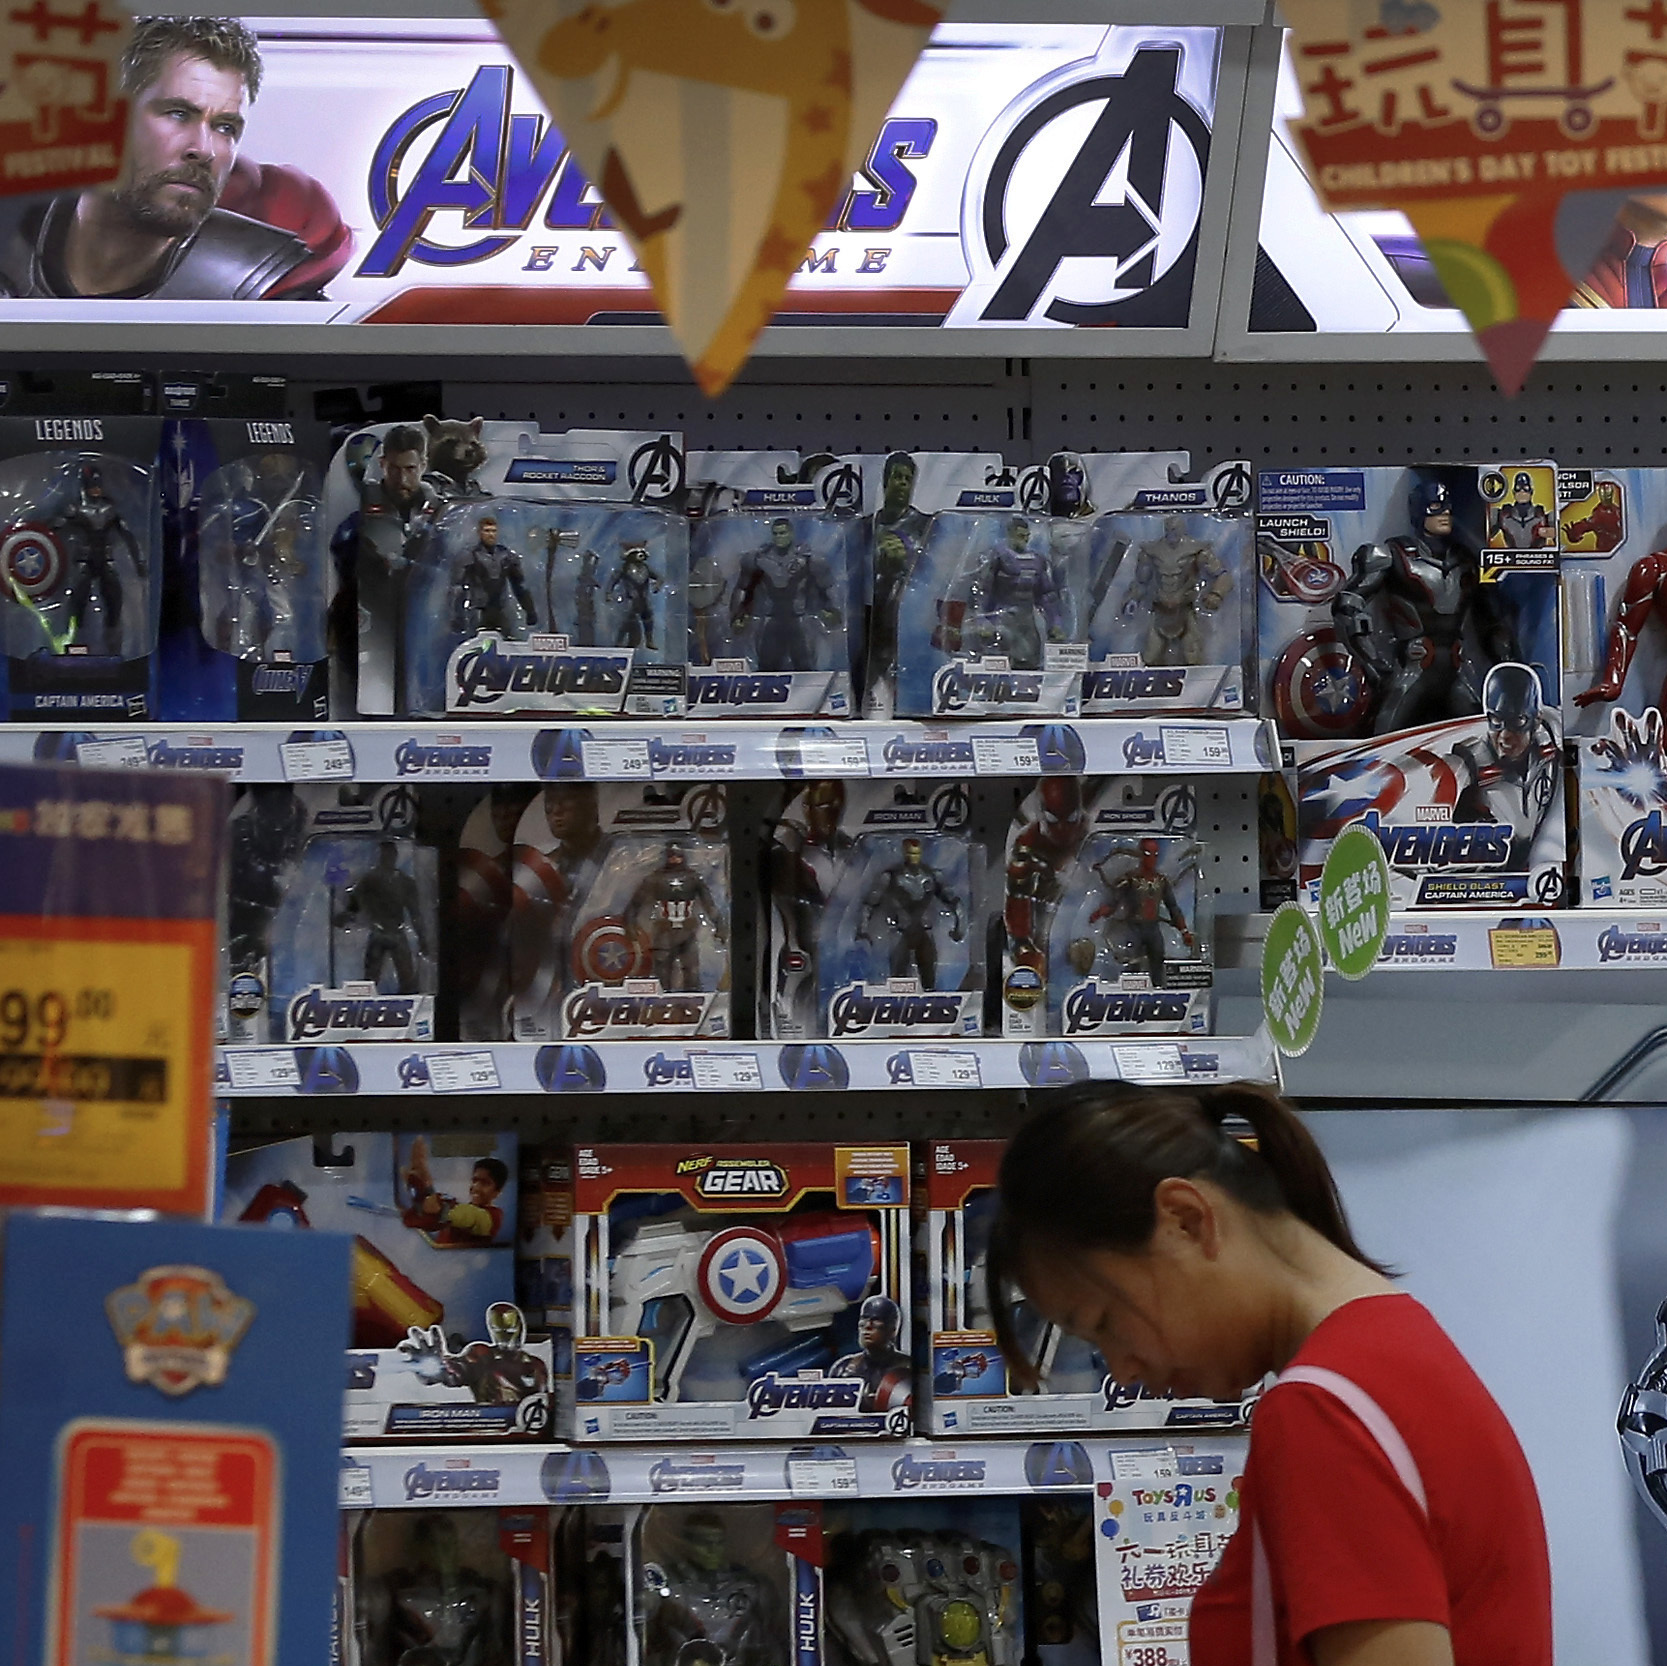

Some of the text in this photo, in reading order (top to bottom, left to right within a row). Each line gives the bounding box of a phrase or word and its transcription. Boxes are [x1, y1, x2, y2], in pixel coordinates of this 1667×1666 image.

[1321, 158, 1472, 191] CHILDREN'S
[1481, 153, 1536, 181] DAY
[1545, 150, 1597, 176] TOY
[35, 420, 104, 441] LEGENDS
[247, 422, 294, 445] LEGENDS
[1280, 474, 1324, 485] CAUTION:
[763, 492, 797, 503] HULK
[1145, 491, 1197, 503] THANOS
[1260, 518, 1308, 528] LAUNCH
[1280, 527, 1326, 538] SHIELD!
[456, 649, 629, 706] AVENGERS
[1326, 860, 1382, 925] 新登场
[1425, 890, 1514, 899] CAPTAIN AMERICA
[290, 986, 413, 1035] AVENGERS
[566, 985, 702, 1036] AVENGERS
[834, 991, 961, 1035] AVENGERS
[1065, 989, 1190, 1032] AVENGERS
[676, 1157, 712, 1175] NERF
[703, 1169, 780, 1193] GEAR
[750, 1378, 861, 1418] AVENGERS
[523, 1598, 542, 1659] HULK
[799, 1591, 814, 1653] HULK
